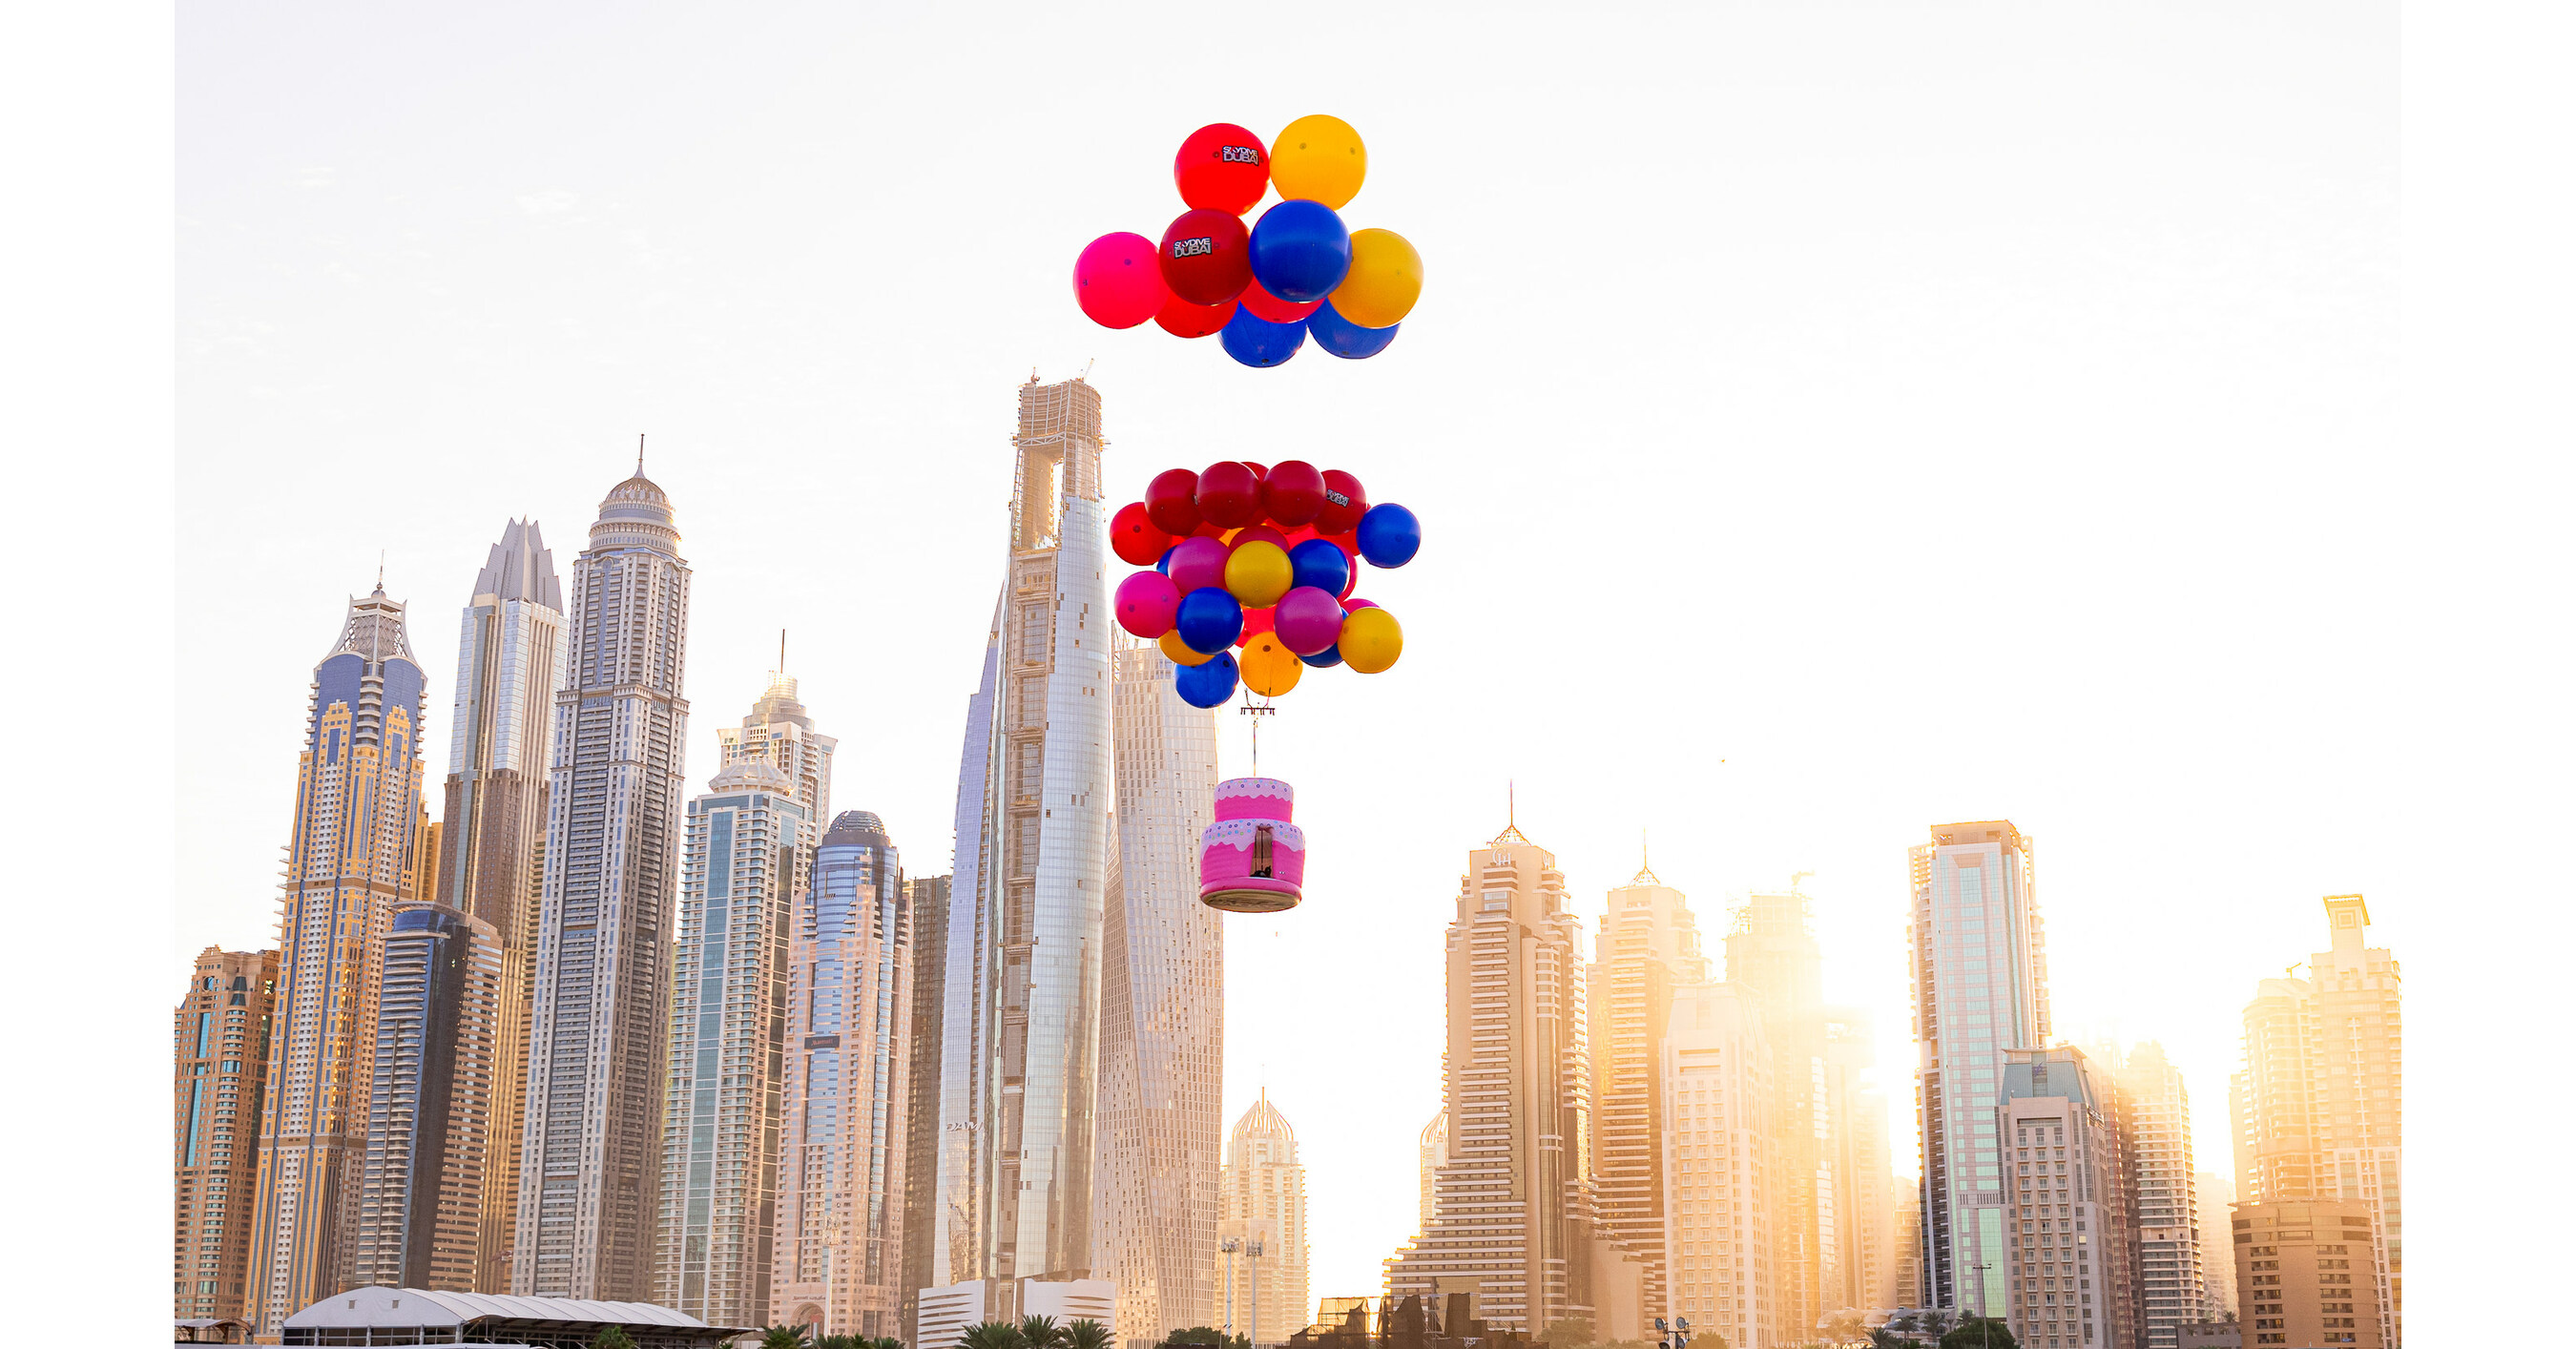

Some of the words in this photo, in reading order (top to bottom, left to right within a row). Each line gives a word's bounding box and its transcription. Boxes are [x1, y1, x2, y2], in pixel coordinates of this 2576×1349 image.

[1223, 153, 1258, 164] DUBAI
[1174, 238, 1211, 249] SKYDIVE
[1174, 243, 1212, 258] DUBAI
